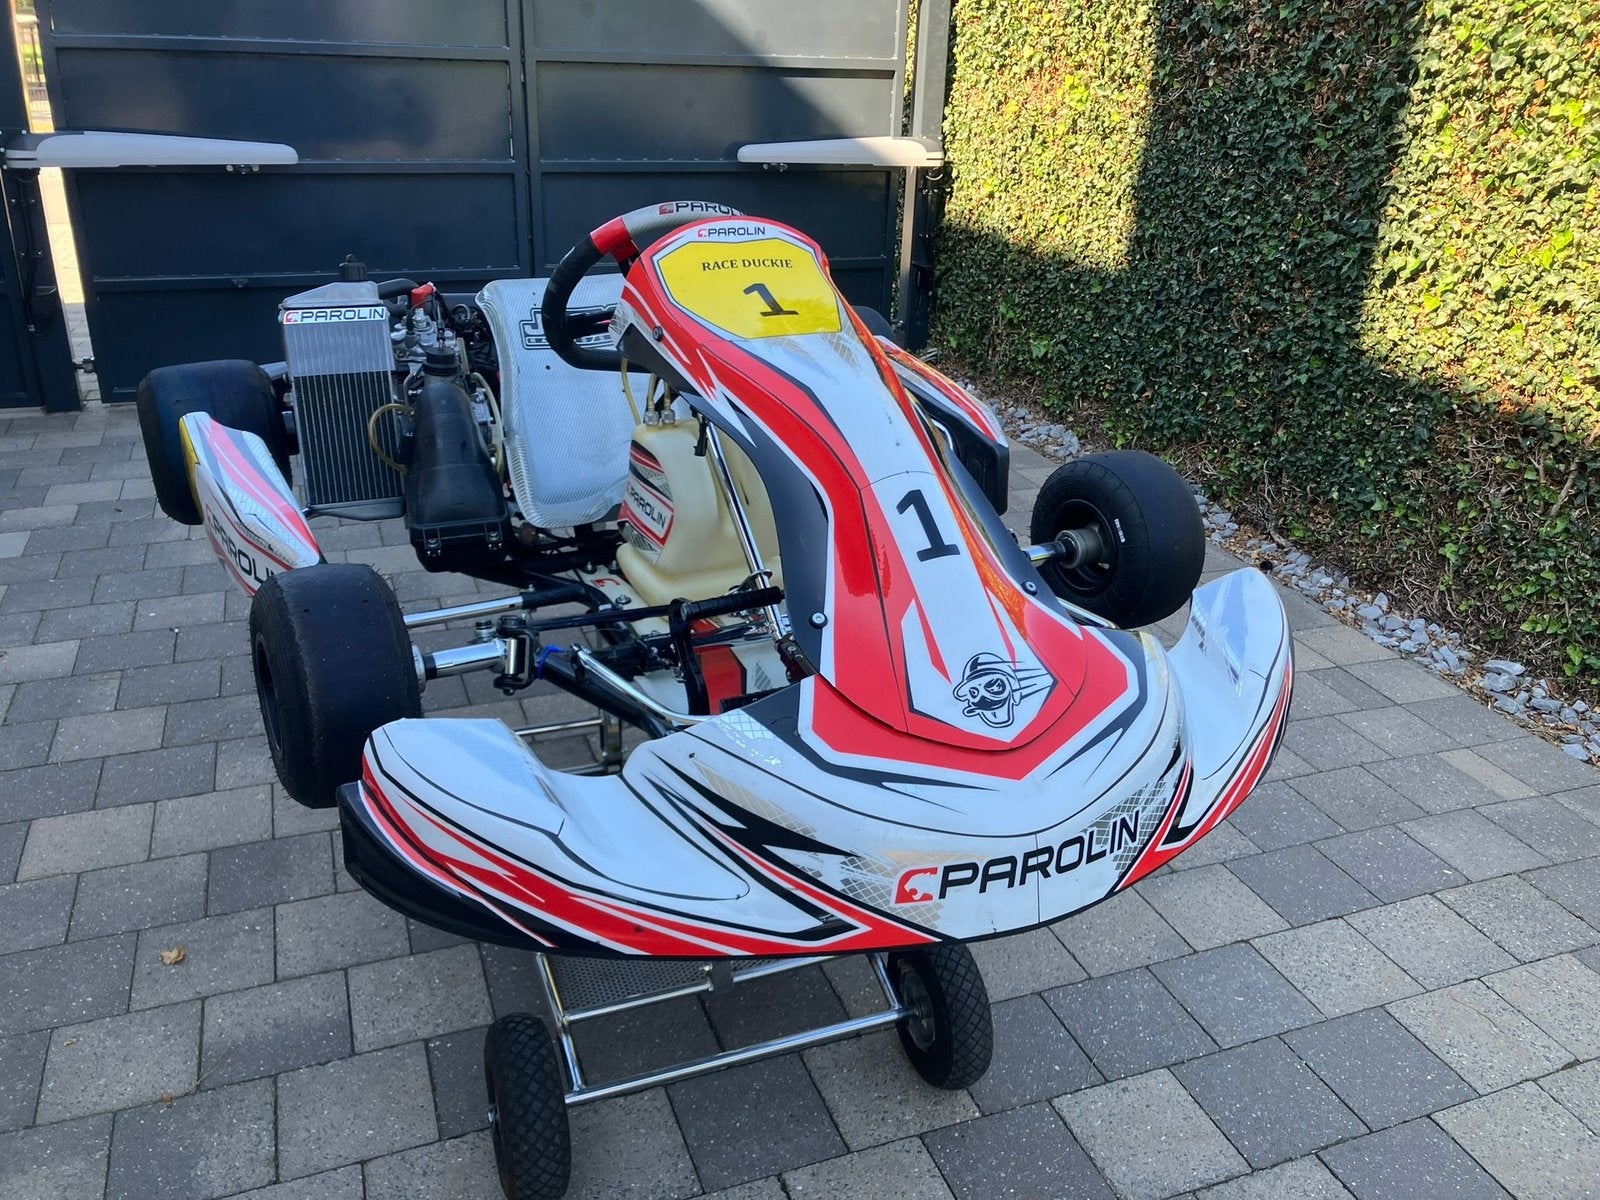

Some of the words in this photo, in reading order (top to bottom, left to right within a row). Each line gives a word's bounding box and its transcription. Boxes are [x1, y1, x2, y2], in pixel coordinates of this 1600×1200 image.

[676, 202, 742, 216] PAROL
[708, 226, 766, 237] PAROLIN
[702, 260, 738, 271] RACE
[742, 259, 793, 269] DUCKIE
[743, 282, 799, 316] 1
[301, 308, 385, 322] PAROLIN
[631, 486, 666, 528] PAROLIN
[896, 489, 960, 562] 1
[939, 810, 1139, 899] PAROLIN
